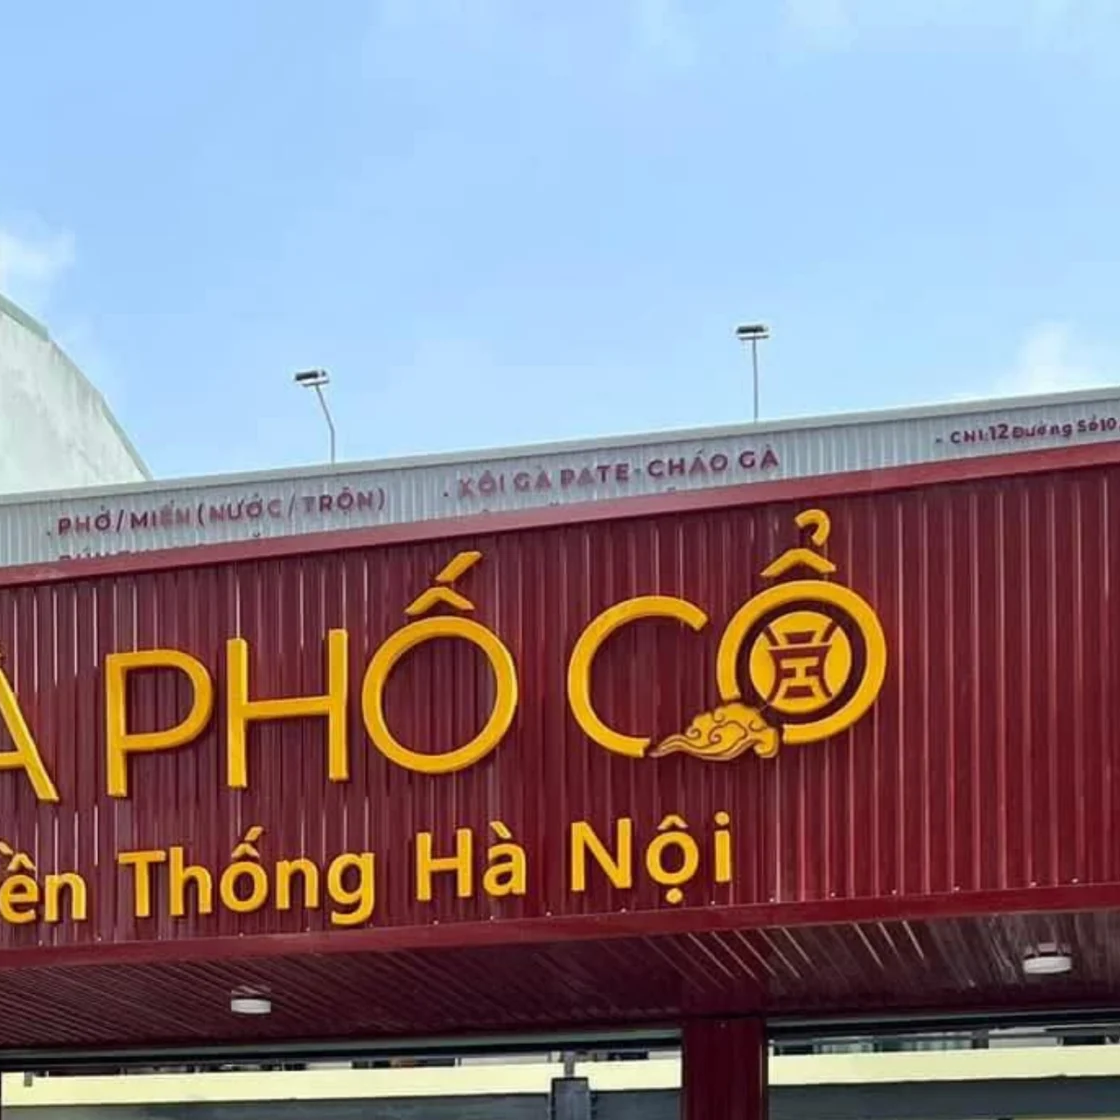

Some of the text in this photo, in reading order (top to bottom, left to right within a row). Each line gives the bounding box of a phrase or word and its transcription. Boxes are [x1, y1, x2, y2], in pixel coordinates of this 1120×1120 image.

[648, 449, 729, 478] CHÁO
[738, 443, 780, 470] GÀ
[105, 551, 520, 798] PHỐ
[568, 509, 888, 758] CỔ
[118, 827, 376, 926] Thống
[416, 821, 528, 902] Hà
[570, 811, 733, 905] Nội
